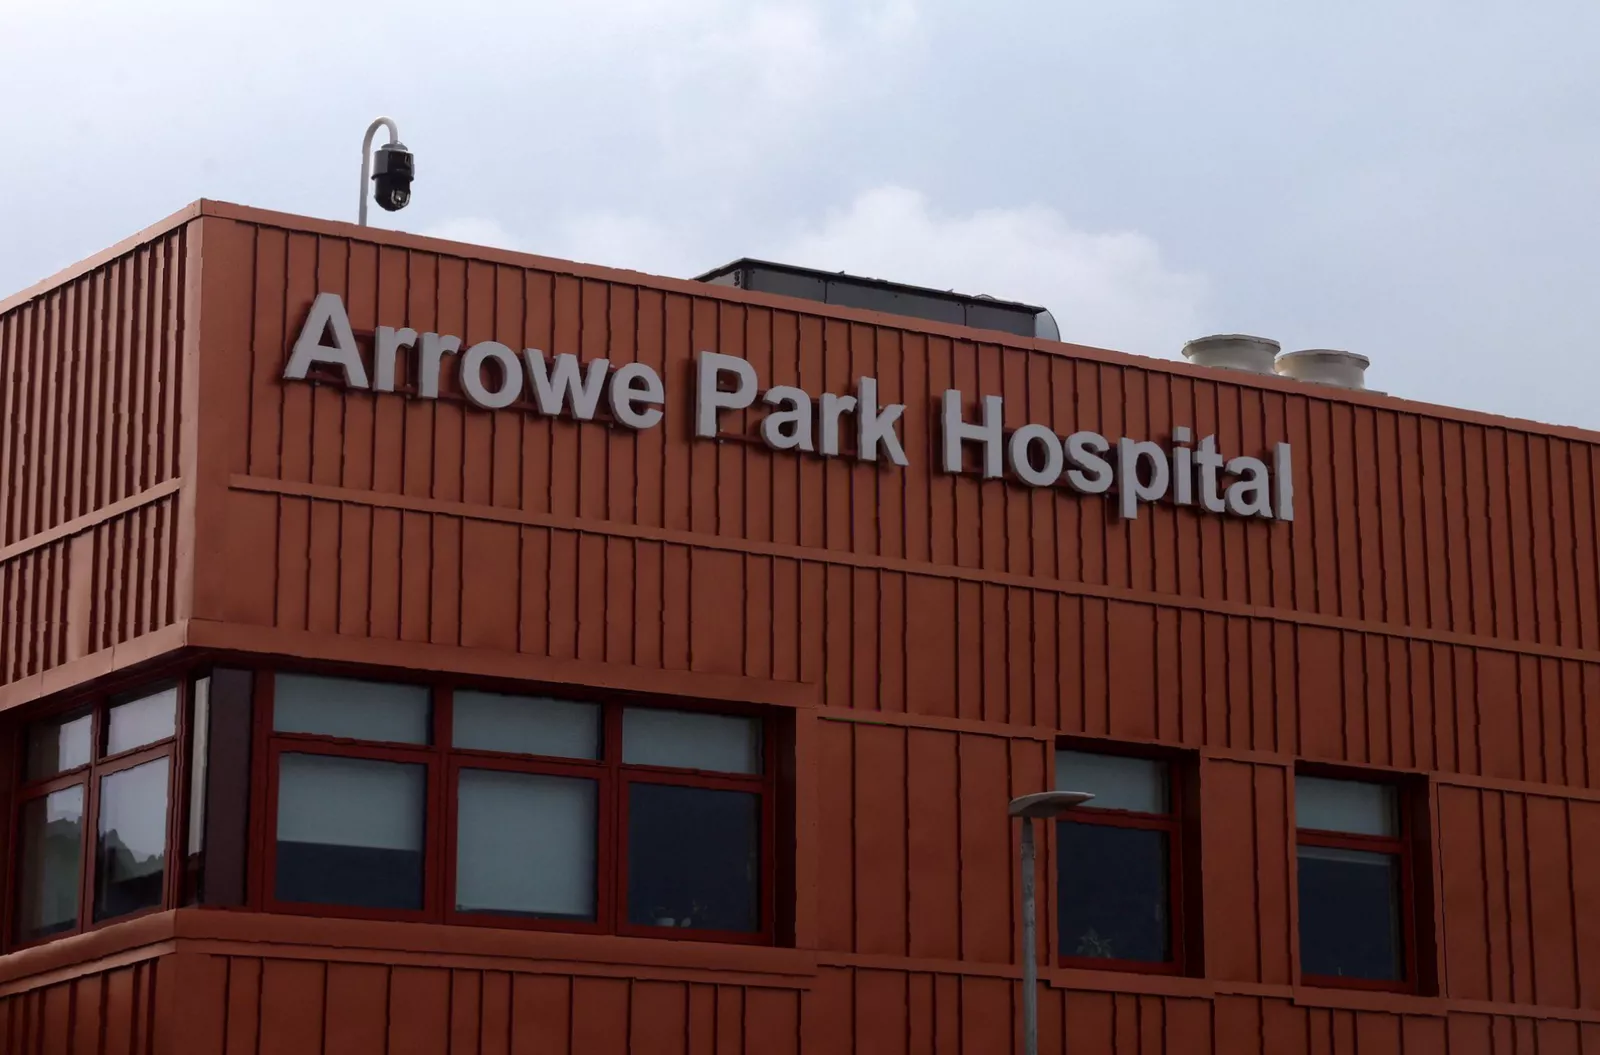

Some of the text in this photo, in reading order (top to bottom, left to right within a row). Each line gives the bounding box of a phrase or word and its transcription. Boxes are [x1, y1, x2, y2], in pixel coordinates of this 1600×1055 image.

[283, 292, 1294, 521] Arrowe Park Hospital
